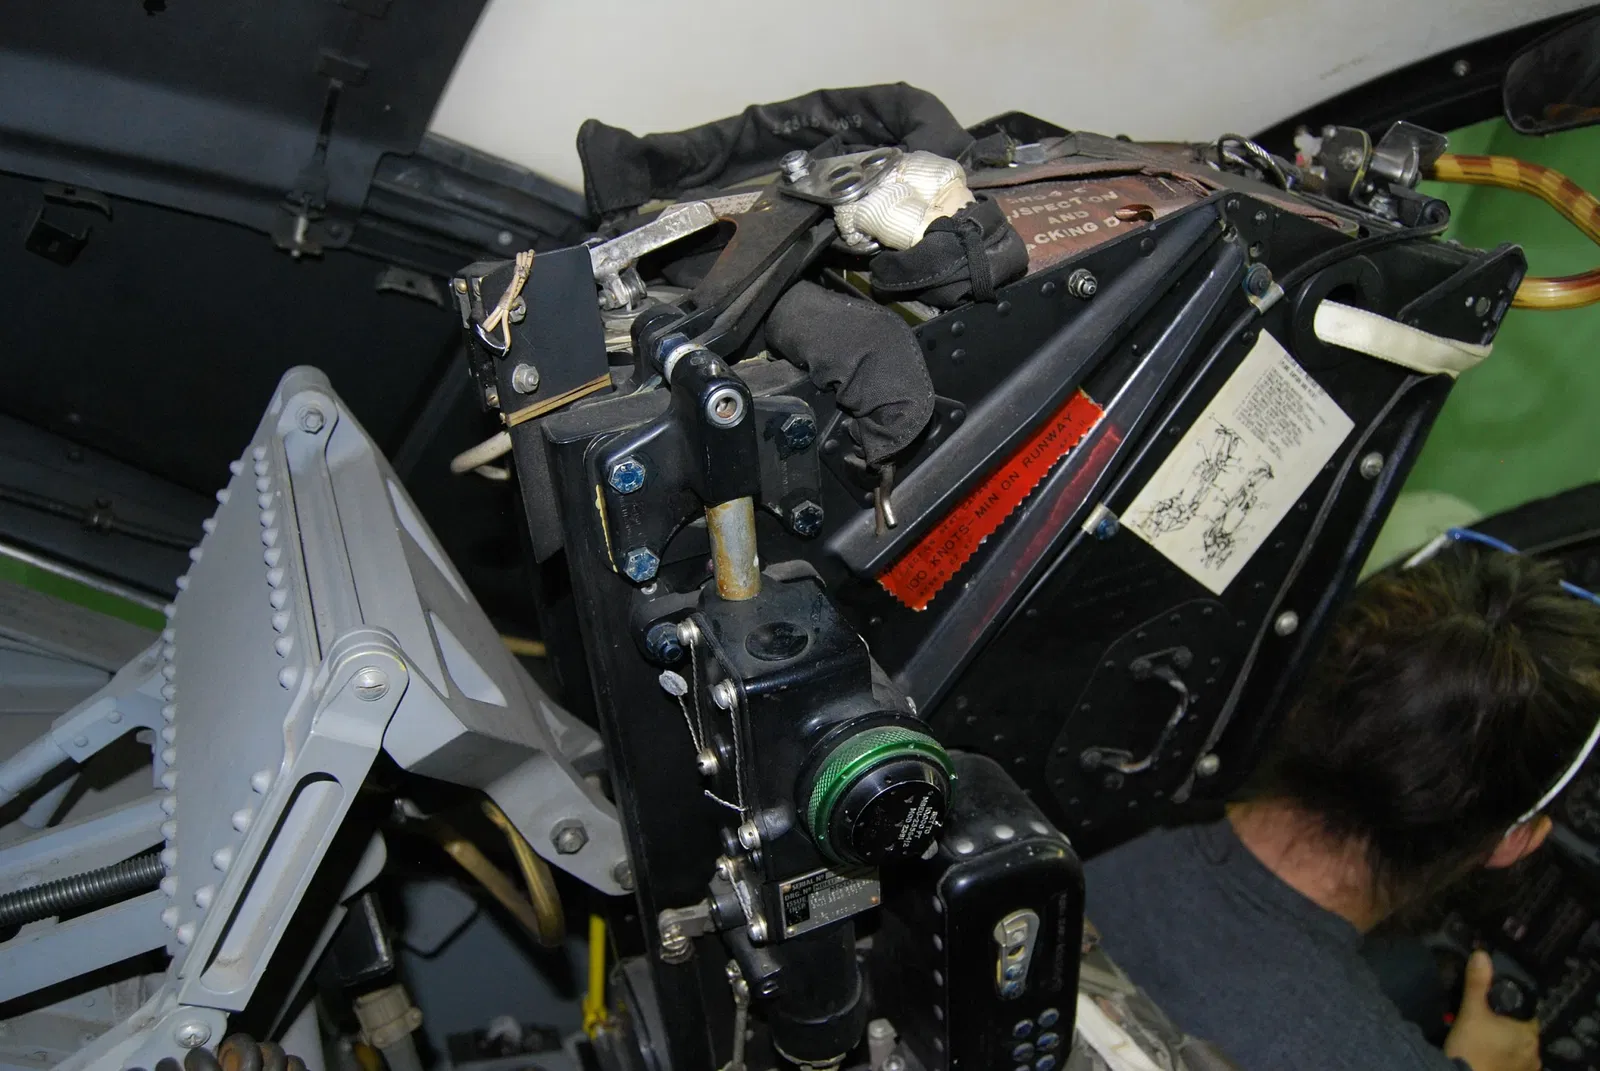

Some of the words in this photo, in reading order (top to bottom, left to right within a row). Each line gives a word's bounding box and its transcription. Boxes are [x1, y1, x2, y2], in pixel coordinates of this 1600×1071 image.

[1048, 210, 1089, 225] AND
[1025, 221, 1099, 256] ACKING
[907, 570, 928, 593] 100
[974, 492, 999, 518] MIN
[1000, 471, 1020, 491] ON
[1022, 412, 1073, 469] RUNWAY
[905, 807, 917, 823] MOD
